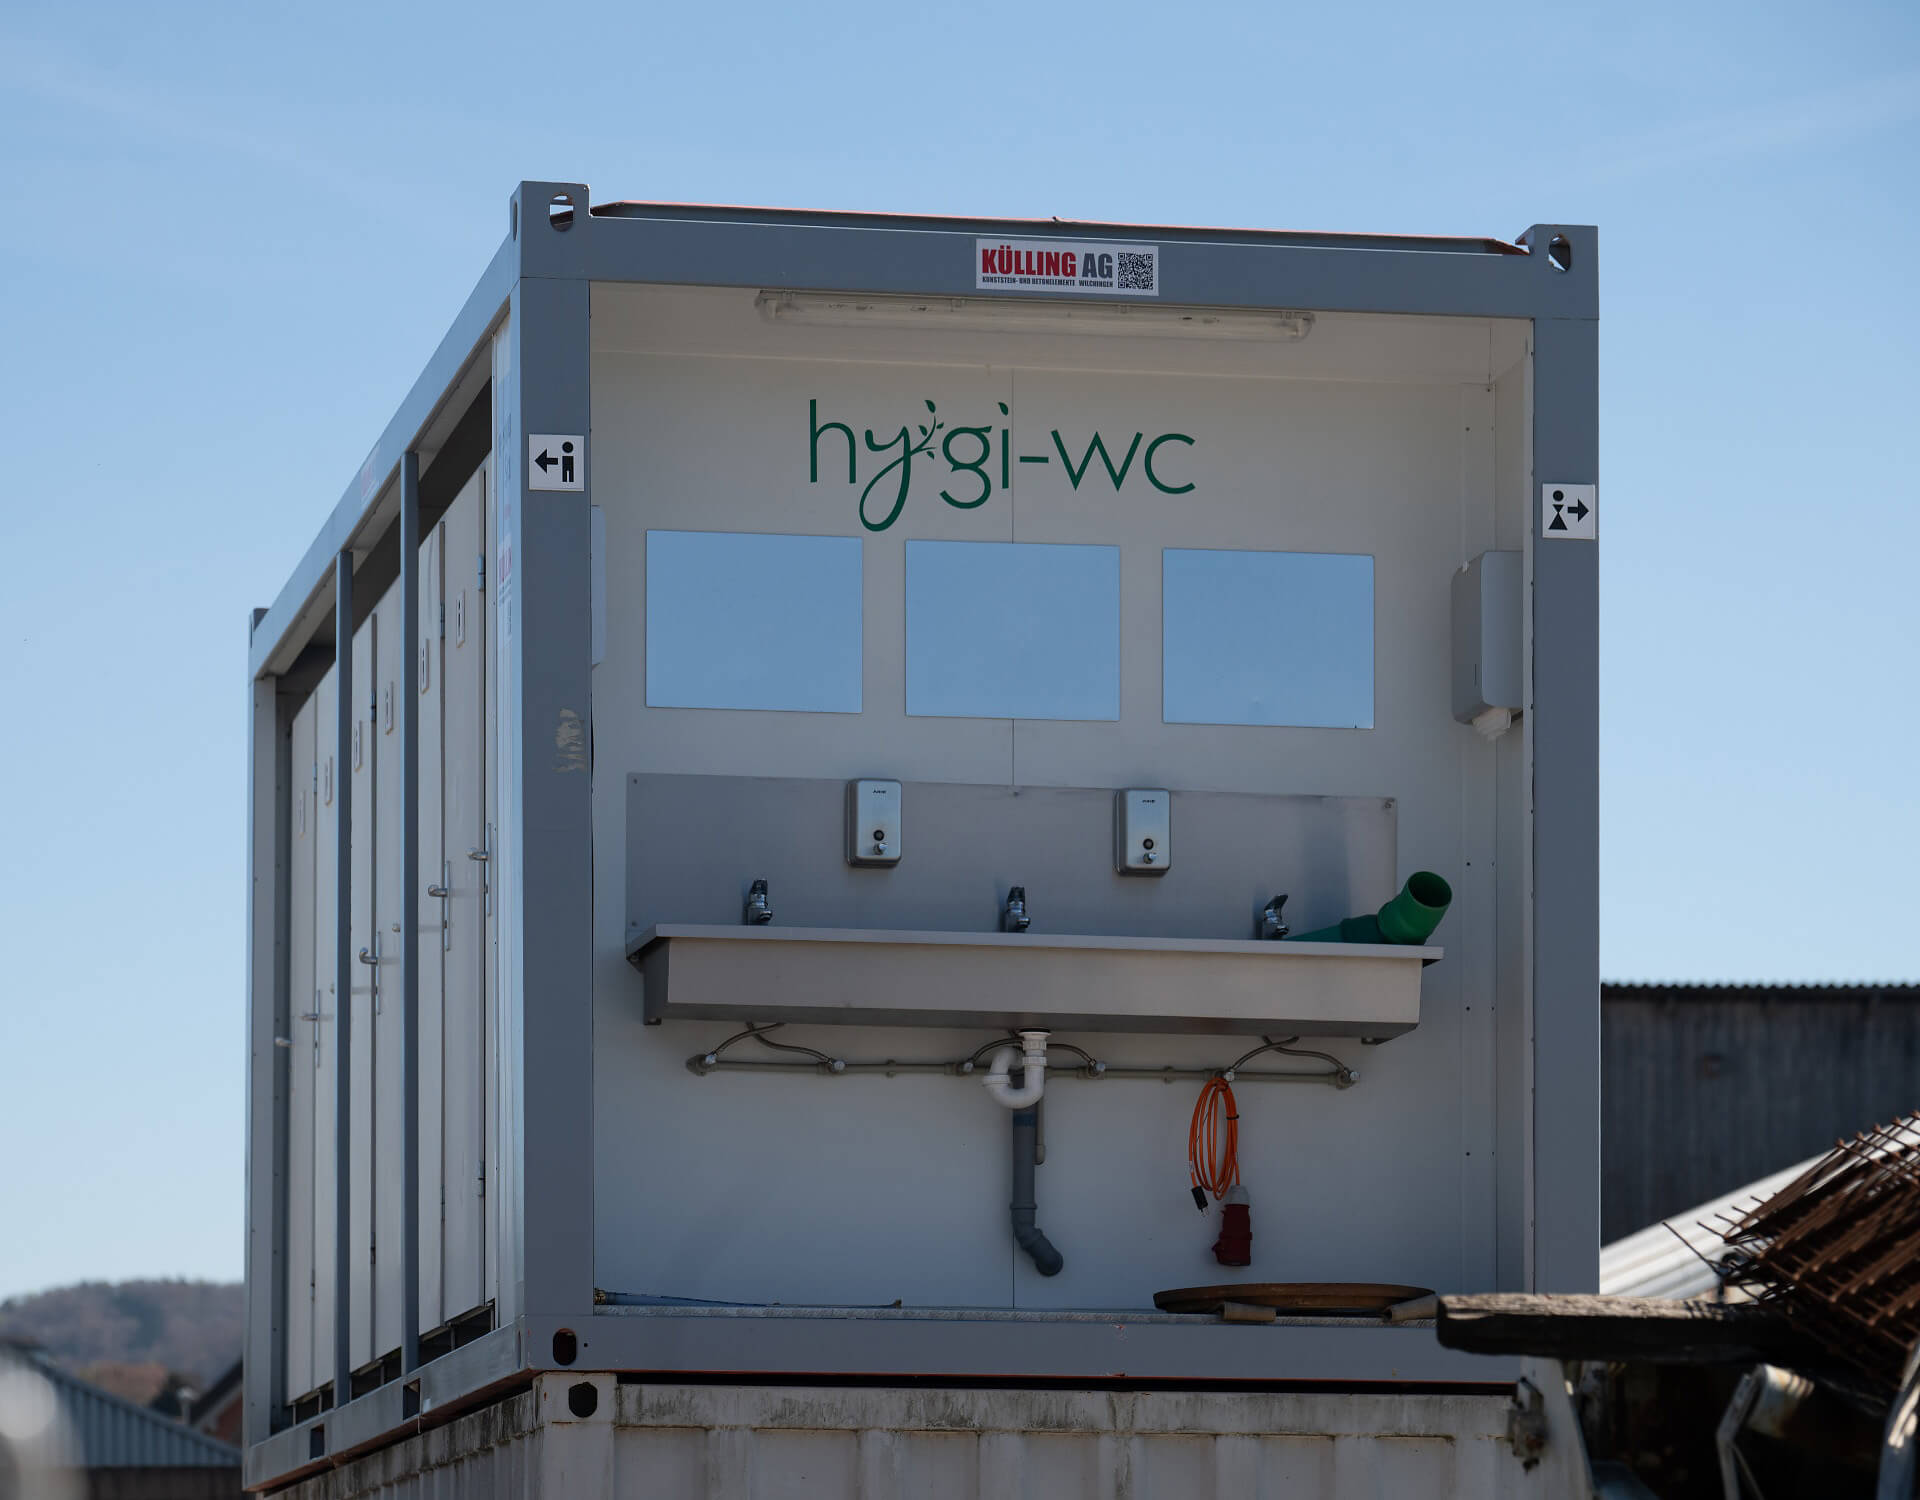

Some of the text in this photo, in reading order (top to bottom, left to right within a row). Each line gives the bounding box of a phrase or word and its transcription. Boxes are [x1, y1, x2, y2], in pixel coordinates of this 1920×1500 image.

[981, 245, 1113, 278] KÜLLING AG
[1019, 277, 1031, 285] UND
[1031, 278, 1076, 286] BETONELEMENTE
[1079, 280, 1113, 288] WILCHINGEN
